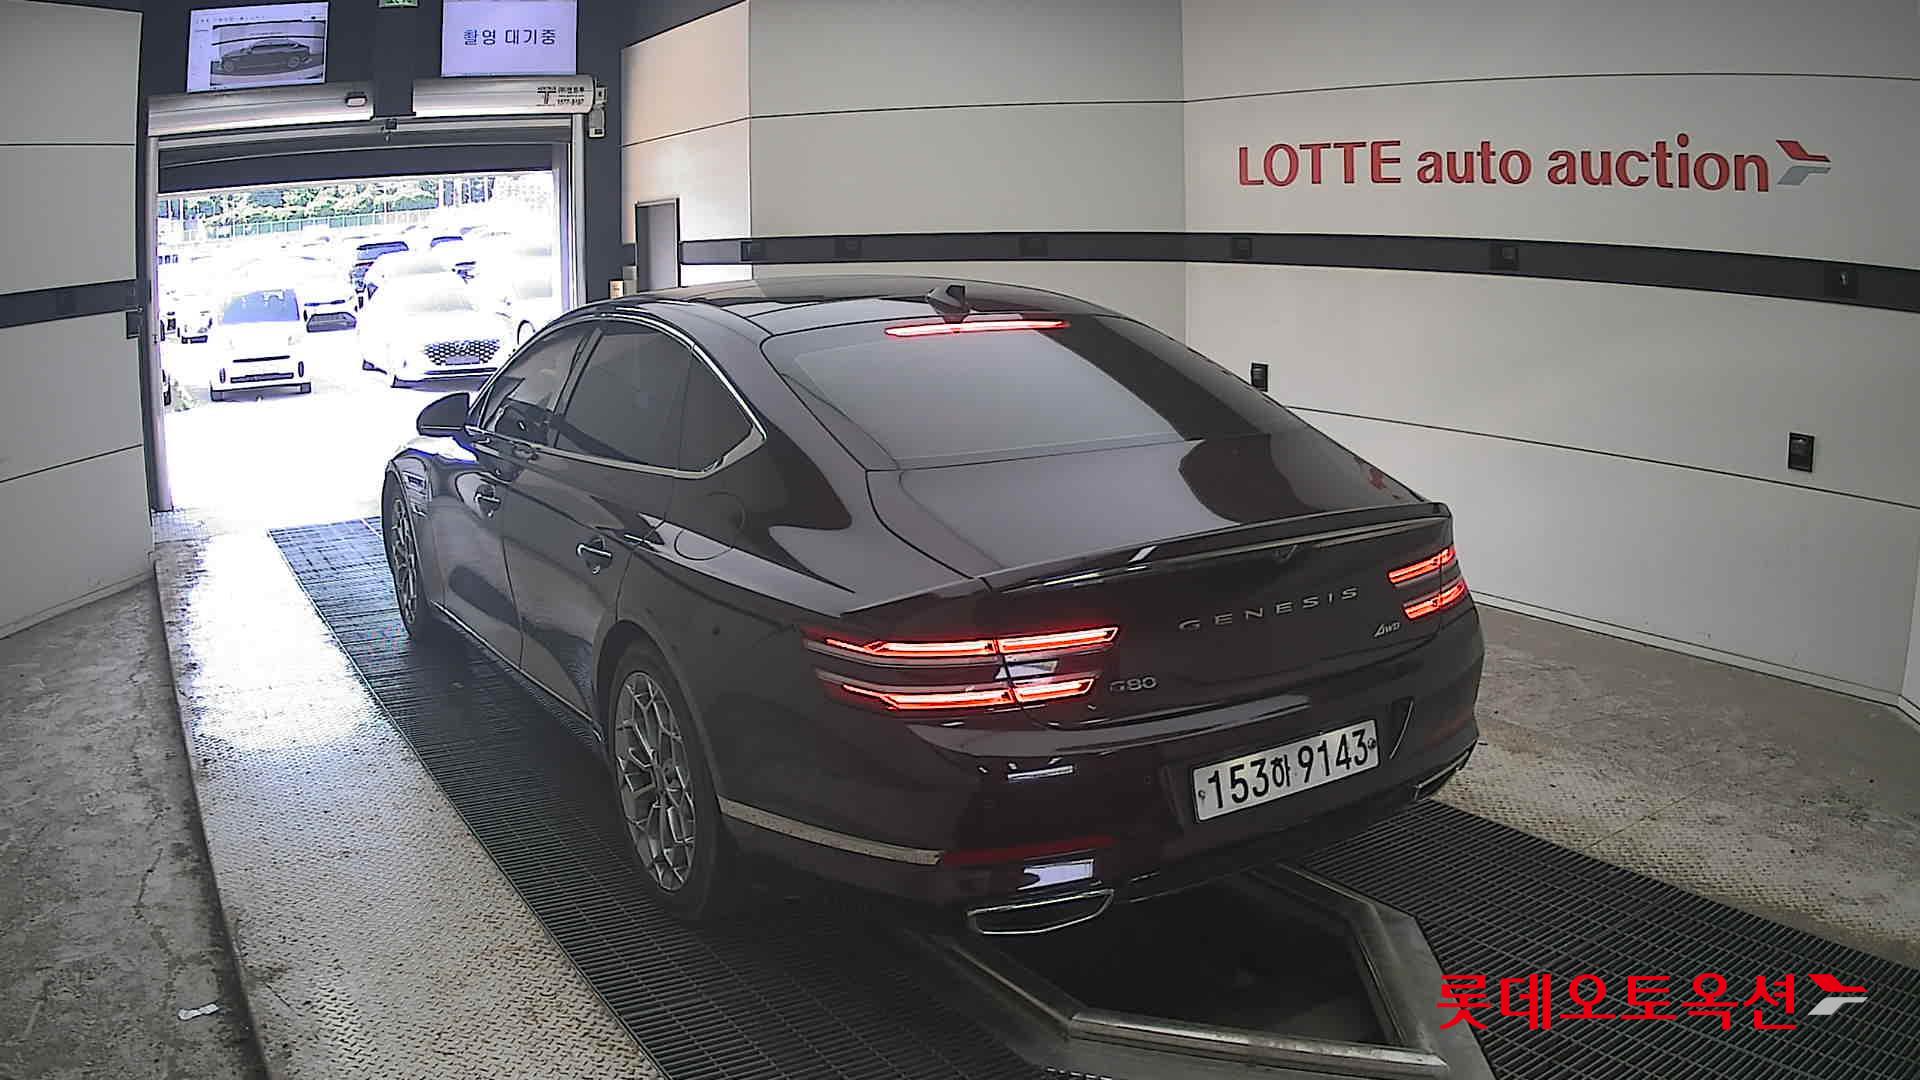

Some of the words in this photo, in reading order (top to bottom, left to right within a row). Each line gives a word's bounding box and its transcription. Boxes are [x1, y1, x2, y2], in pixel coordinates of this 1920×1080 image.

[505, 29, 556, 45] 대기중
[1239, 140, 1402, 188] LOTTE
[1417, 141, 1533, 186] auto
[1547, 133, 1770, 193] auction
[1179, 586, 1358, 631] GENESIS
[1374, 622, 1401, 638] AWD
